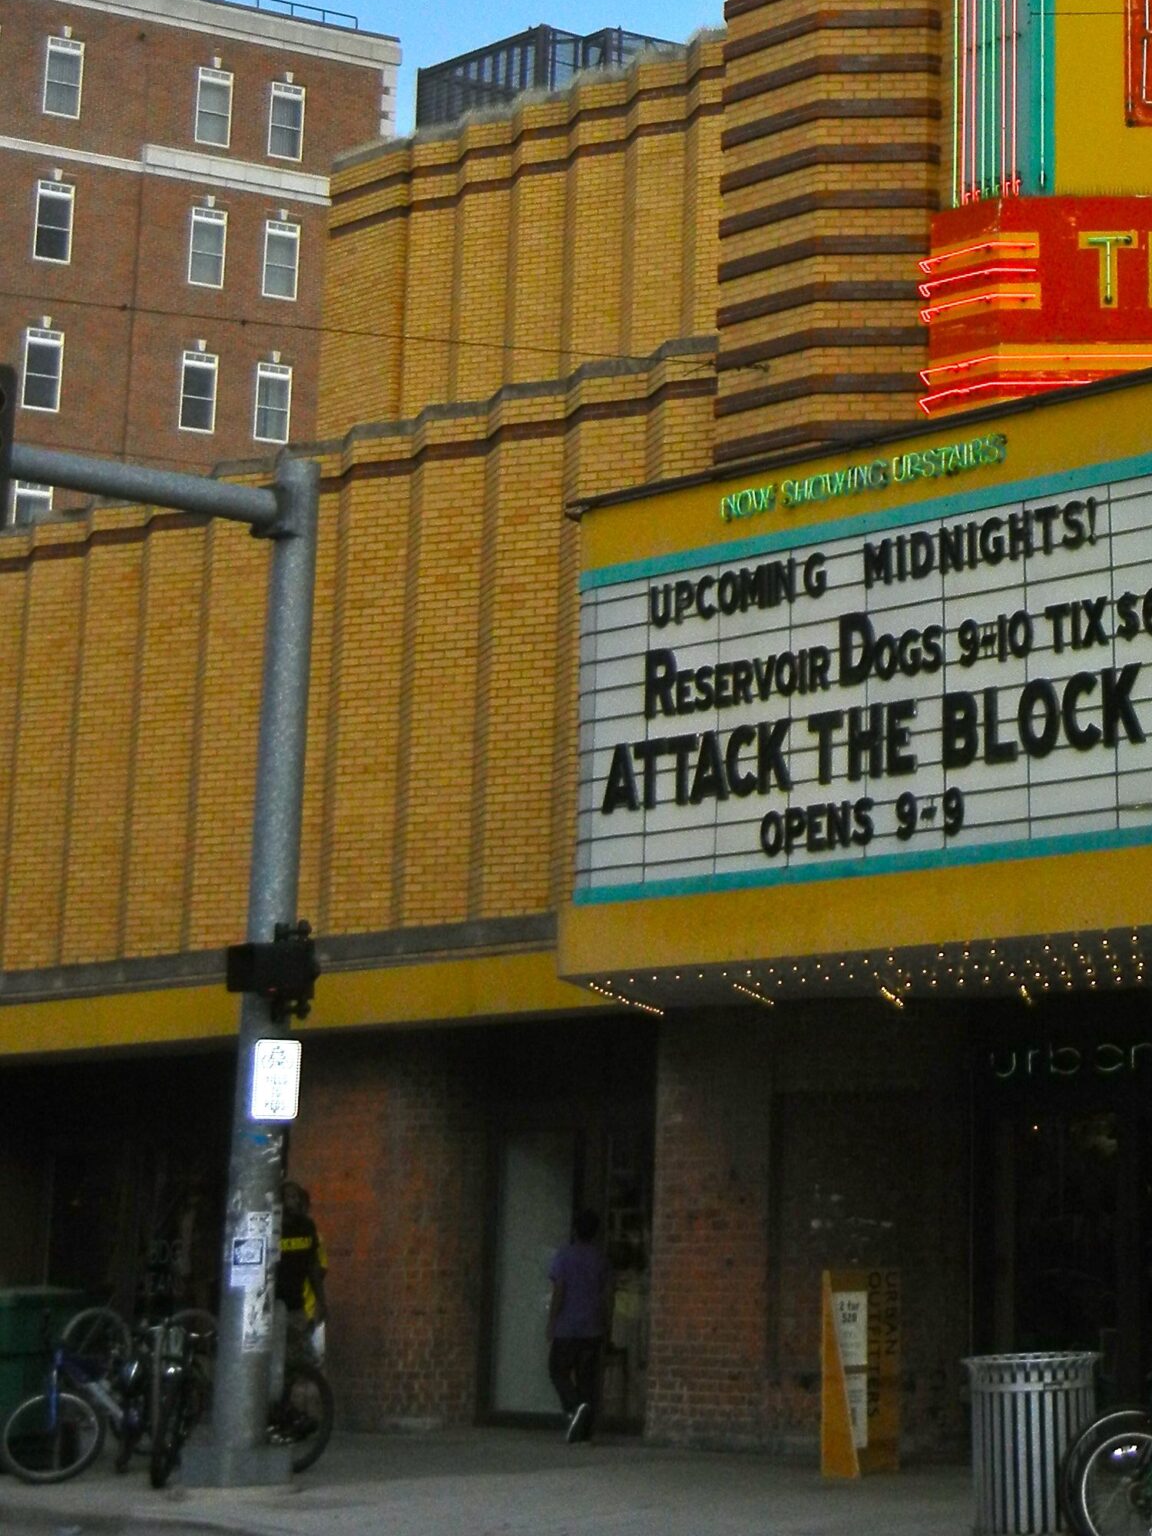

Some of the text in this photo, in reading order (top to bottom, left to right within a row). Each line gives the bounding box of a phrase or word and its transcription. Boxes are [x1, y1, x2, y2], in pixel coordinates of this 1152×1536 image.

[720, 433, 1007, 521] NOW SHOWING UPSTAIRS
[650, 497, 1099, 629] UPCOMING MIDNIGHTS!
[644, 643, 831, 720] RESERVOIR
[837, 611, 943, 688] DOGS
[1043, 594, 1108, 654] TIX
[600, 662, 1147, 816] ATTACK THE BLOCK
[759, 795, 875, 858] OPENS
